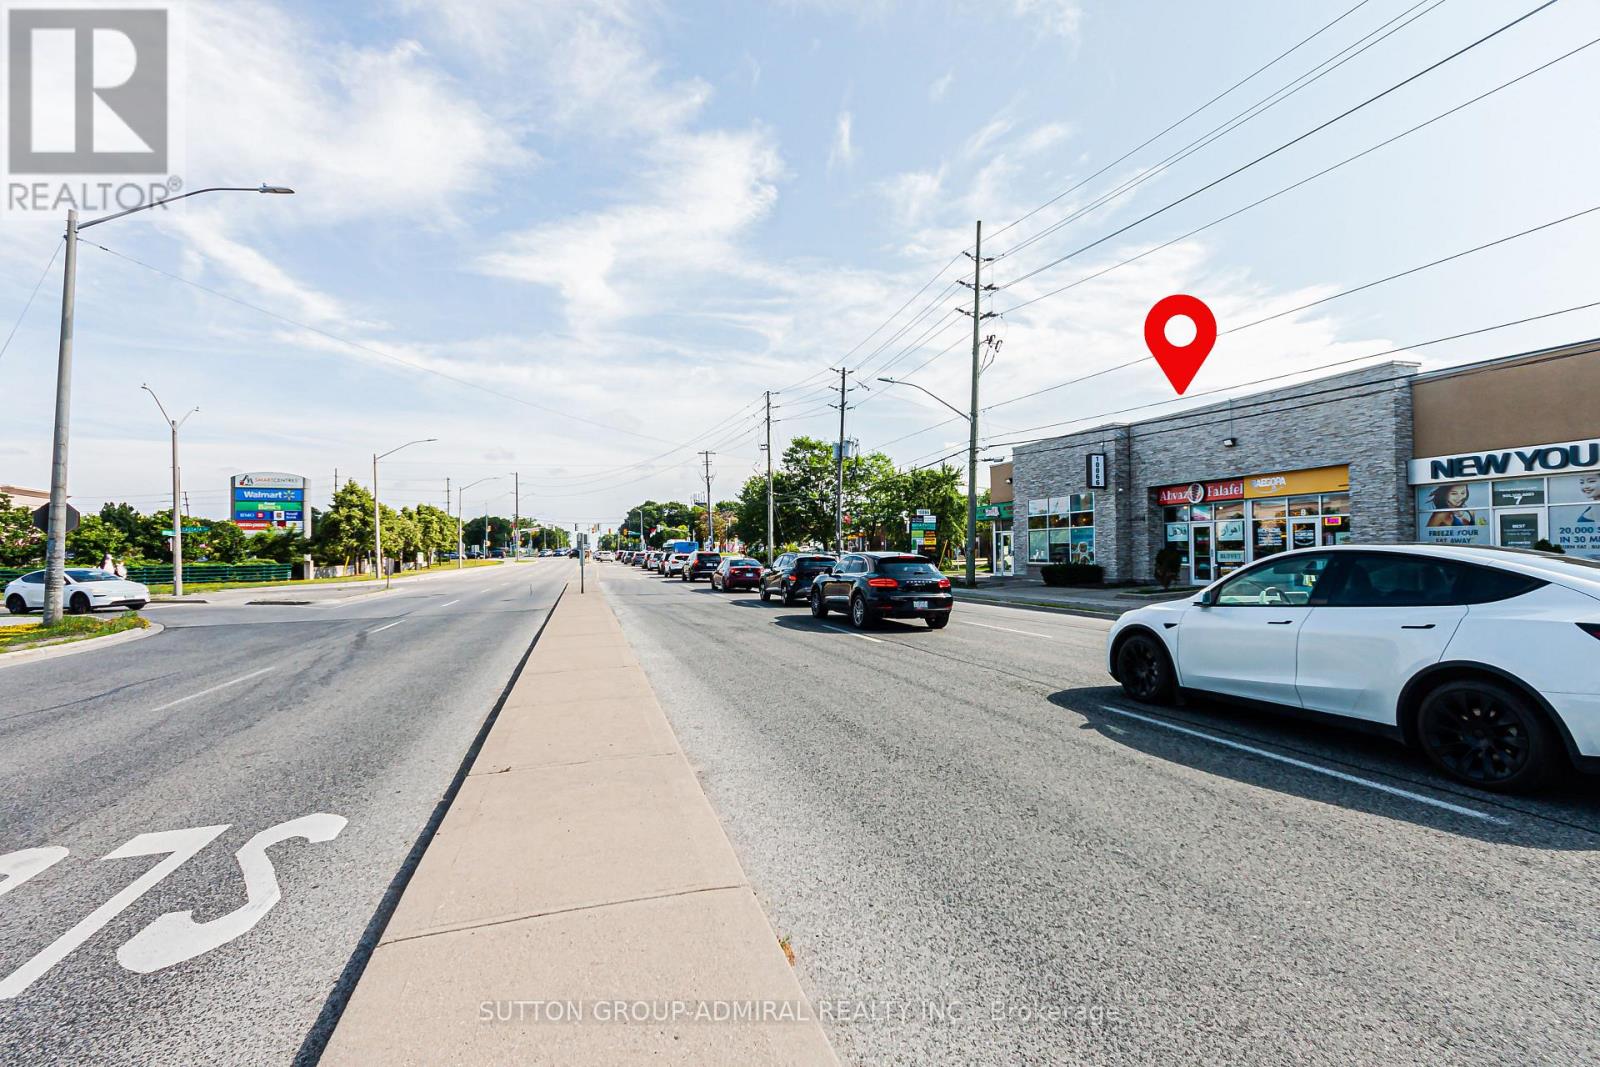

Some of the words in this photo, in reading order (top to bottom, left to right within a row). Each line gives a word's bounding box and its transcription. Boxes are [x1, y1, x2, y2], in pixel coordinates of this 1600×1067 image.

[1430, 453, 1511, 480] NEW
[1514, 443, 1599, 471] YOU
[1207, 483, 1244, 497] Falafel
[243, 491, 282, 499] Walmart
[1514, 496, 1523, 505] 7
[1429, 529, 1453, 537] FREEZE
[1559, 527, 1594, 535] 20,000
